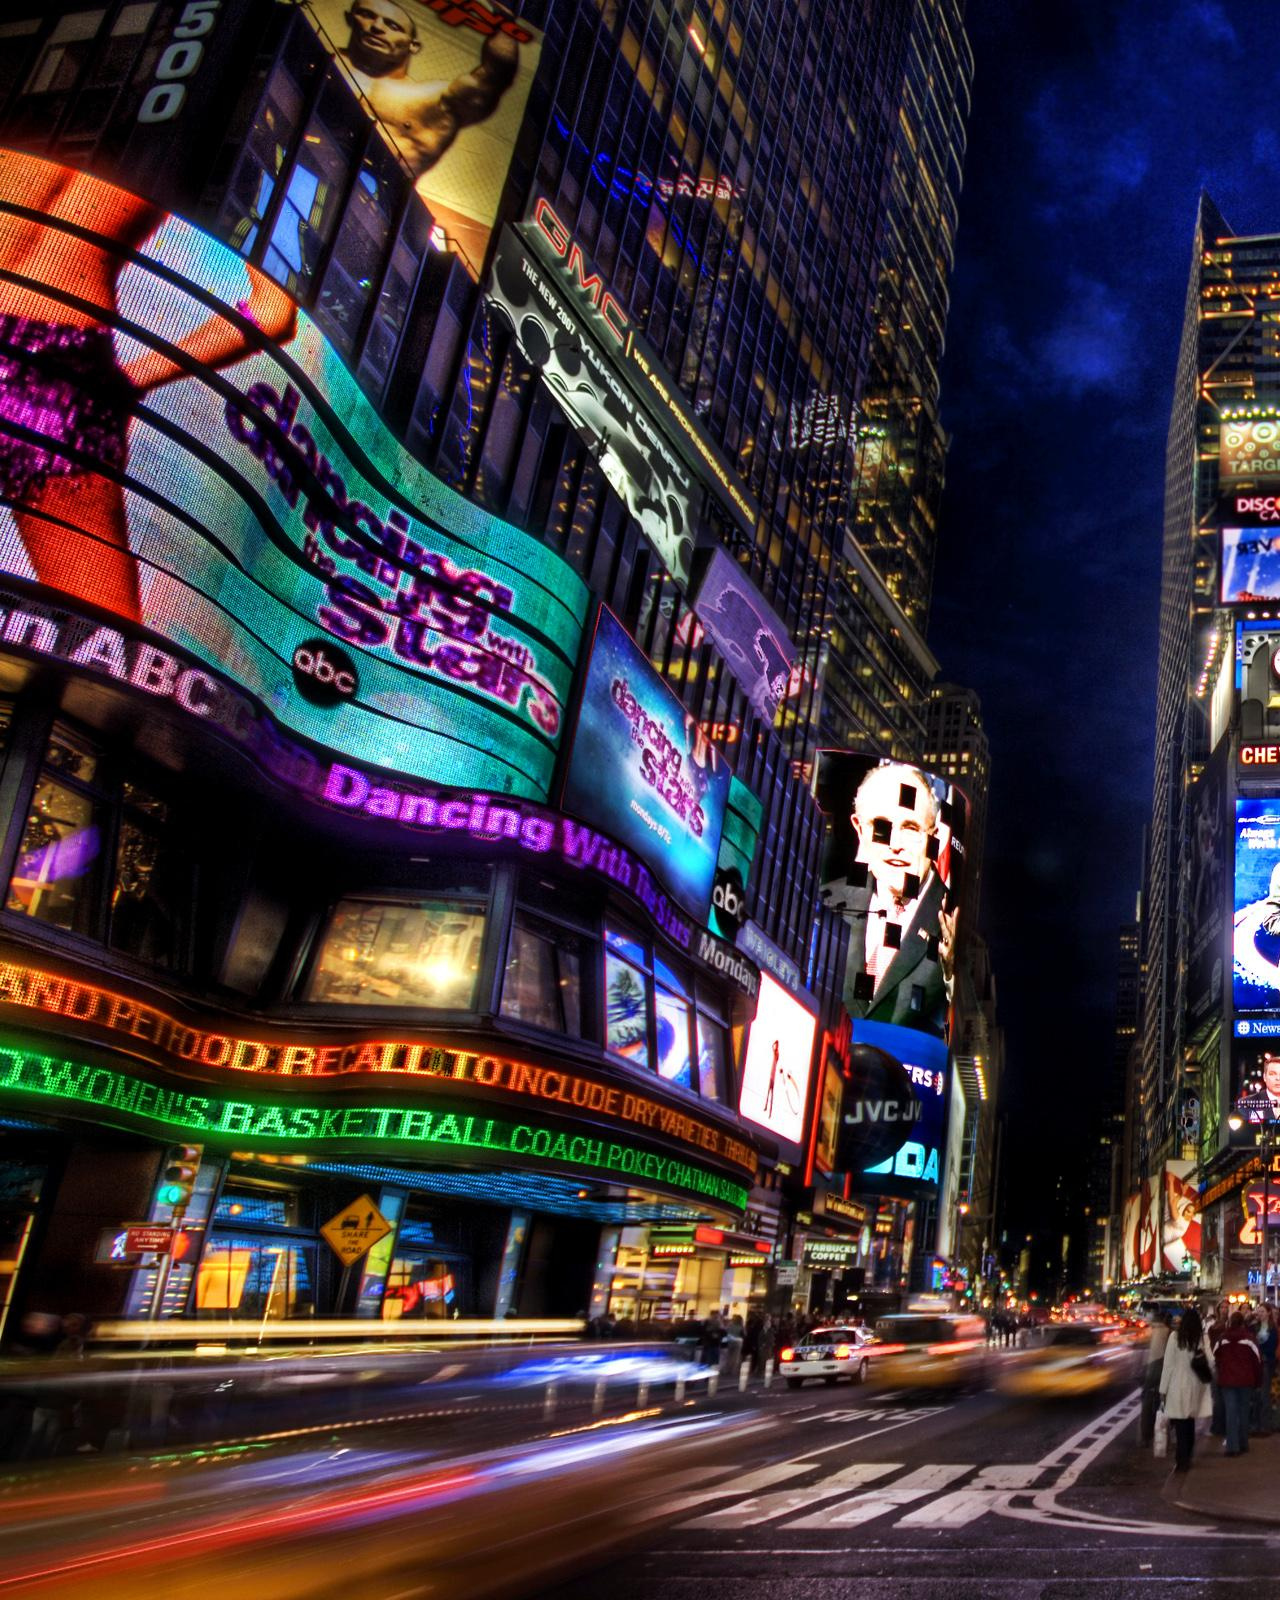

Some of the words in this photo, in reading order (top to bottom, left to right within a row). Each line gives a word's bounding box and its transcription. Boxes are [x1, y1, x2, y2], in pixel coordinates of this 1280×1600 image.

[137, 0, 221, 124] 500
[533, 197, 628, 347] GMC
[521, 257, 540, 286] THE
[578, 332, 634, 415] YUKON
[68, 625, 218, 717] ABC
[293, 648, 356, 695] abc
[321, 762, 555, 852] Dancing
[562, 819, 633, 888] With
[41, 1056, 208, 1130] WOMEN'S
[219, 1101, 504, 1150] BASKETBALL
[510, 1125, 603, 1167] COACH
[607, 1145, 667, 1183] POKEY
[278, 1043, 437, 1077] RECALL
[446, 1049, 501, 1086] TO
[507, 1063, 622, 1116] INCLUDE
[622, 1094, 658, 1126] DRY
[845, 1100, 899, 1124] JVC
[810, 1252, 848, 1262] COFFEE
